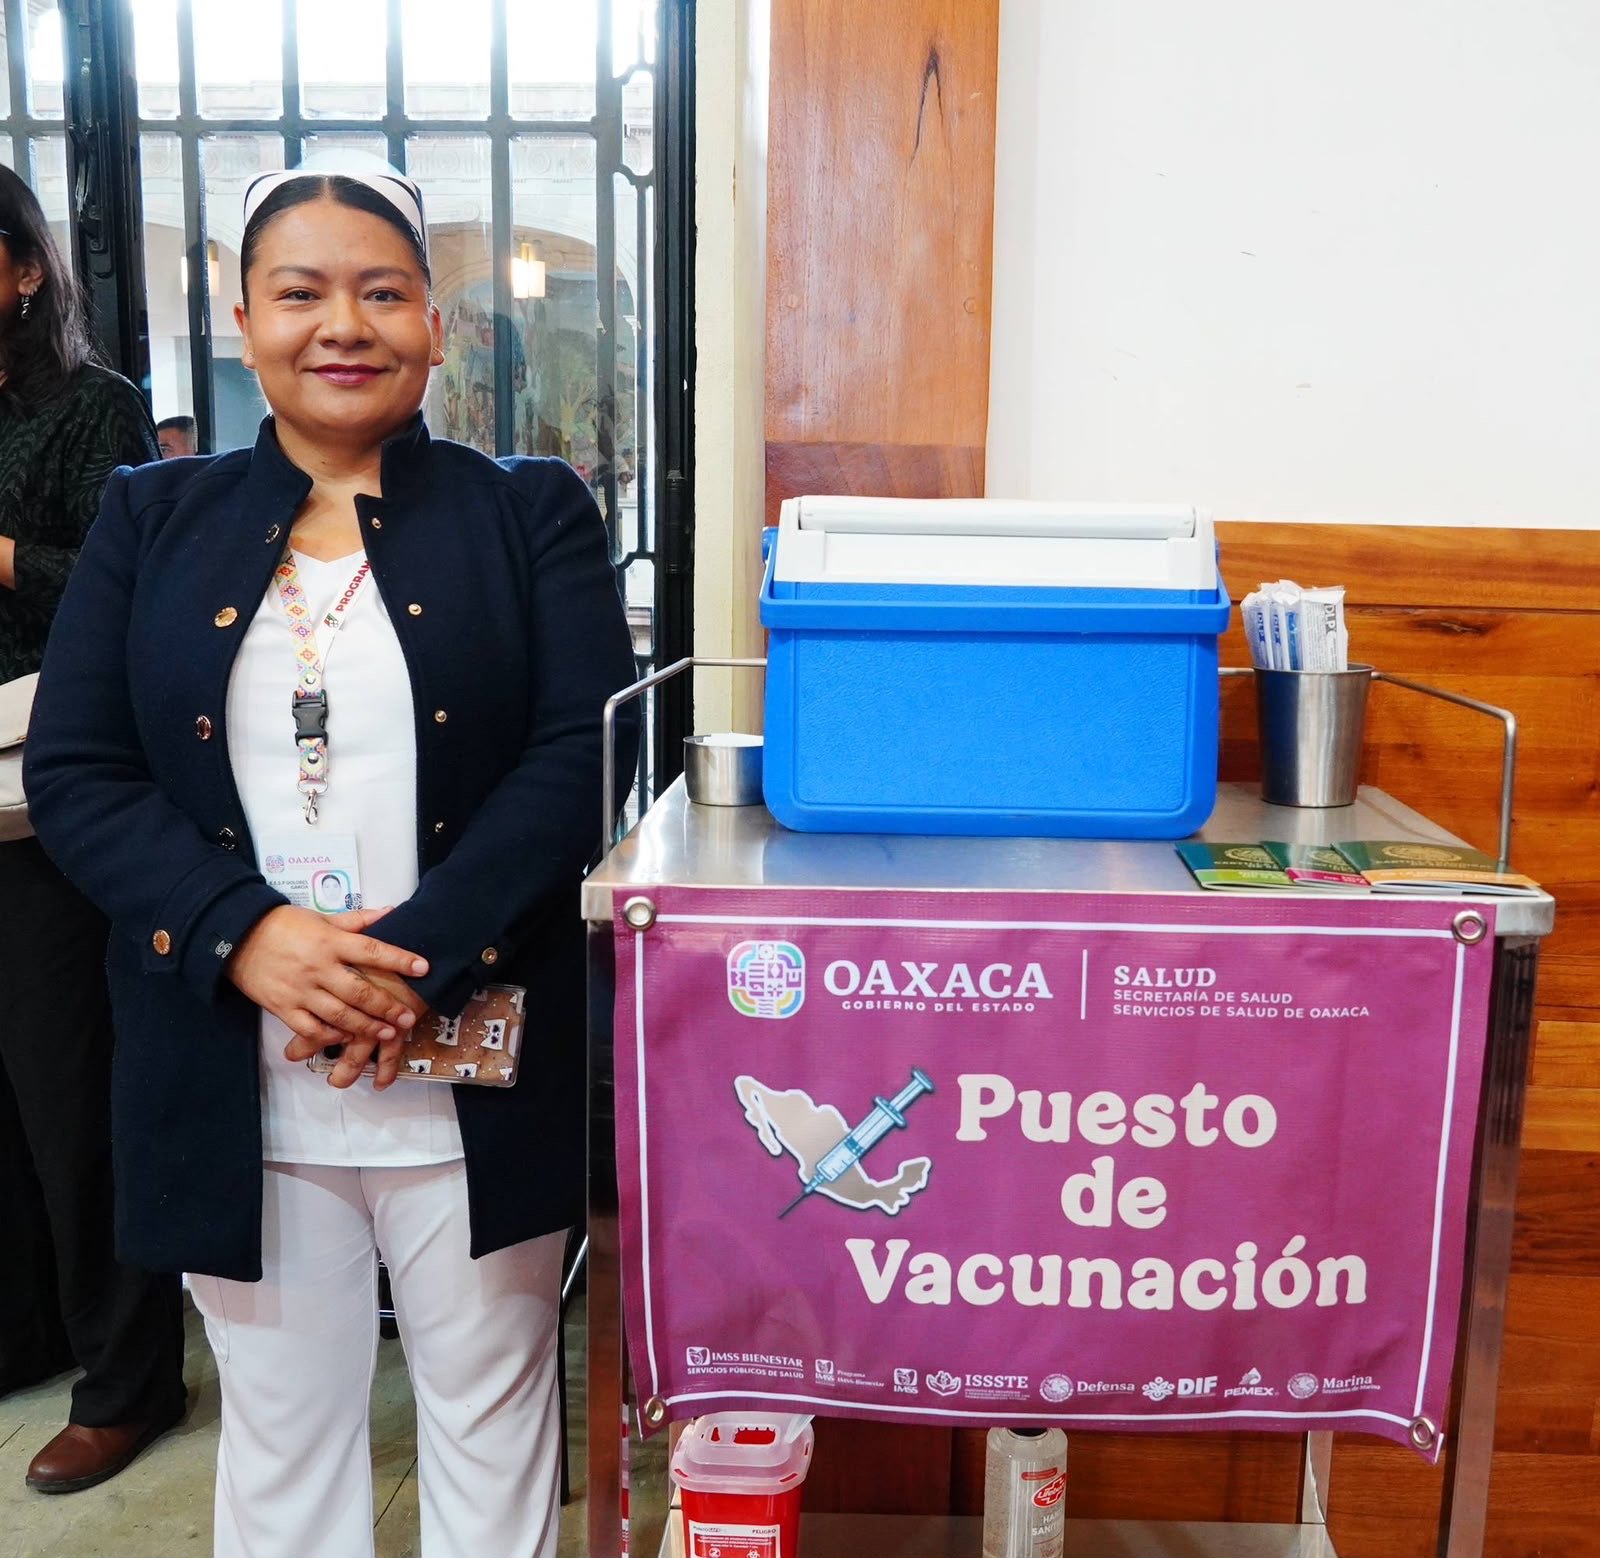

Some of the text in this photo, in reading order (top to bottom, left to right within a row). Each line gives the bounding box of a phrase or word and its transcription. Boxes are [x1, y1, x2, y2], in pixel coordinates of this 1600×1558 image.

[823, 959, 1054, 999] OAXACA
[1114, 965, 1217, 988] SALUD
[1114, 989, 1293, 1004] SECRETARÍA DE SALUD
[841, 1000, 1035, 1012] GOBIERNO DEL ESTADO
[1113, 1004, 1370, 1018] SERVICIOS DE SALUD DE OAXACA
[956, 1073, 1277, 1148] Puesto
[1060, 1156, 1167, 1229] de
[844, 1235, 1367, 1311] Vacunación
[712, 1352, 804, 1368] IMSS BIENESTAR
[688, 1367, 727, 1375] SERVICIOS
[730, 1367, 767, 1375] PÚBLICOS
[780, 1371, 804, 1379] SALUD
[965, 1374, 1029, 1389] ISSSTE
[1077, 1381, 1135, 1392] Defensa
[1177, 1376, 1218, 1395] DIF
[1323, 1375, 1373, 1389] Marina
[894, 1385, 918, 1394] IMSS
[1224, 1387, 1274, 1398] PEMEX
